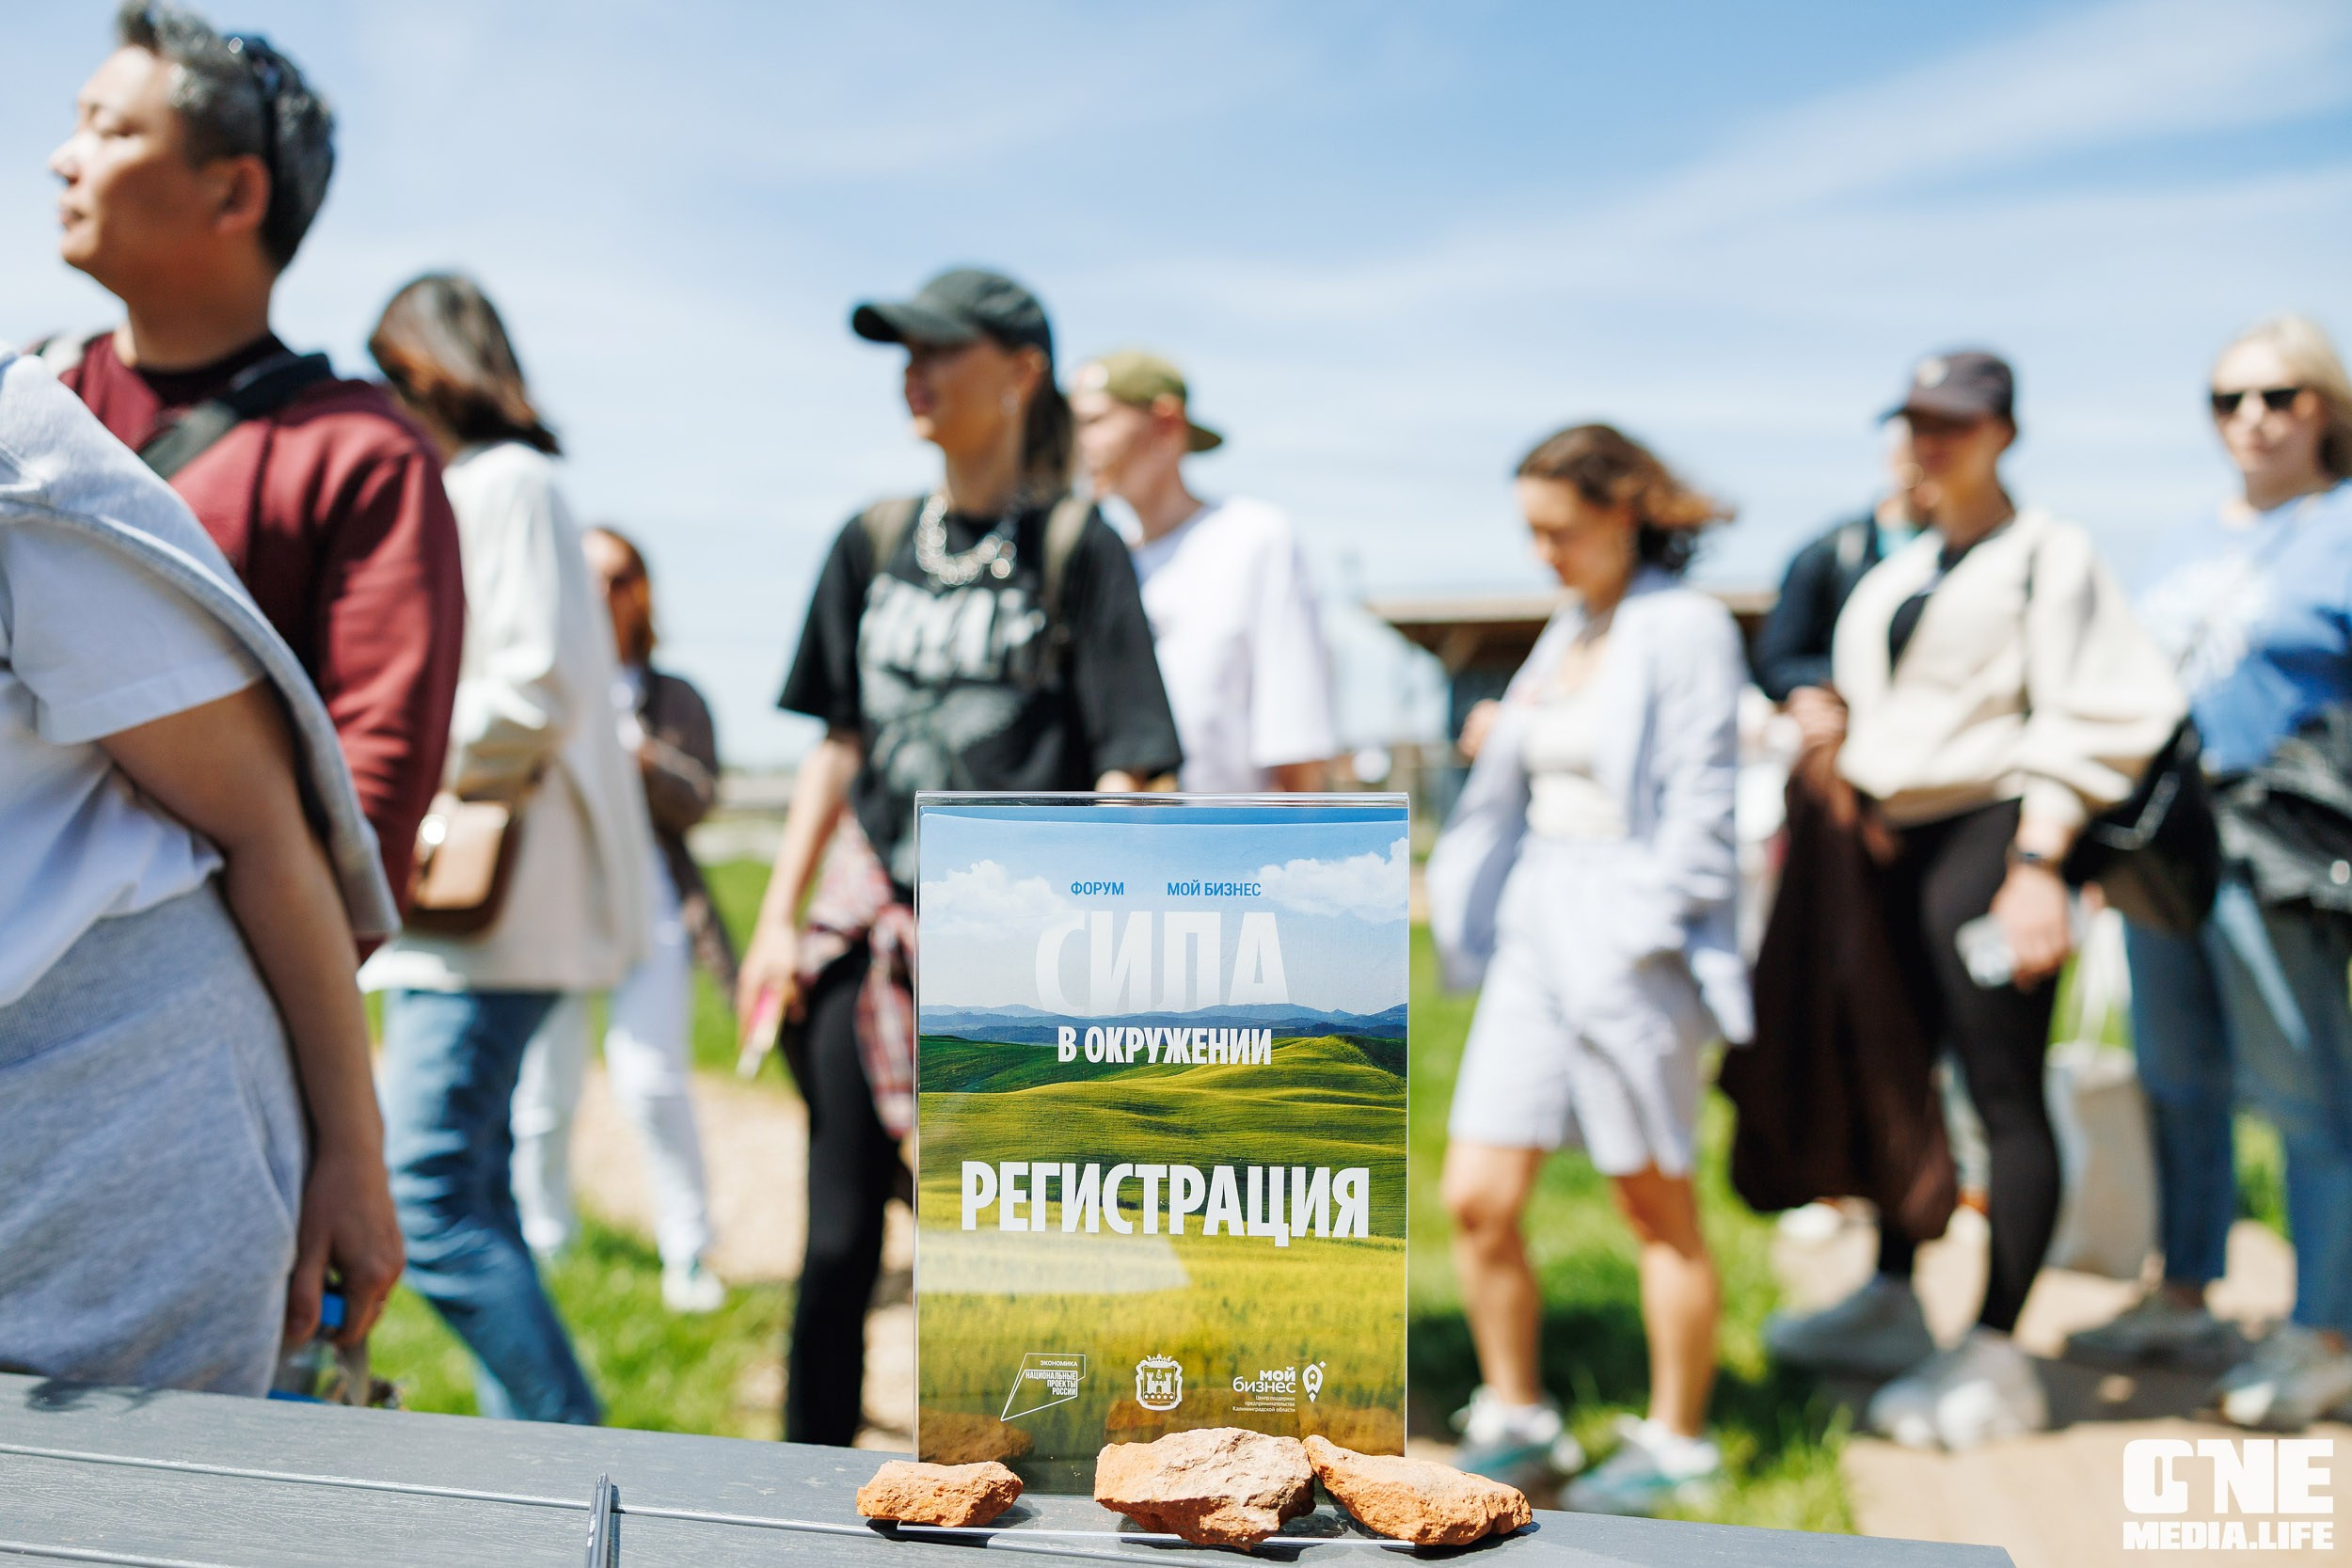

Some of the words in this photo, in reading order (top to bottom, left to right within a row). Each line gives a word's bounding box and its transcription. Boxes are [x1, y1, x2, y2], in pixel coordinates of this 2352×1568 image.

[1071, 880, 1124, 895] ФОРУМ
[1167, 879, 1200, 896] МОЙ
[1204, 882, 1262, 896] БИЗНЕС
[1035, 910, 1290, 1017] СИЛА
[1057, 1026, 1077, 1063] В
[1084, 1026, 1272, 1065] ОКРУЖЕНИИ
[961, 1161, 1370, 1247] РЕГИСТРАЦИЯ
[1025, 1371, 1076, 1380] НАЦИОНАЛЬНЫЕ
[1259, 1367, 1296, 1382] мой
[1047, 1380, 1076, 1388] ПРОЕКТЫ
[1052, 1387, 1076, 1396] РОССИИ
[1232, 1376, 1296, 1393] бизнес
